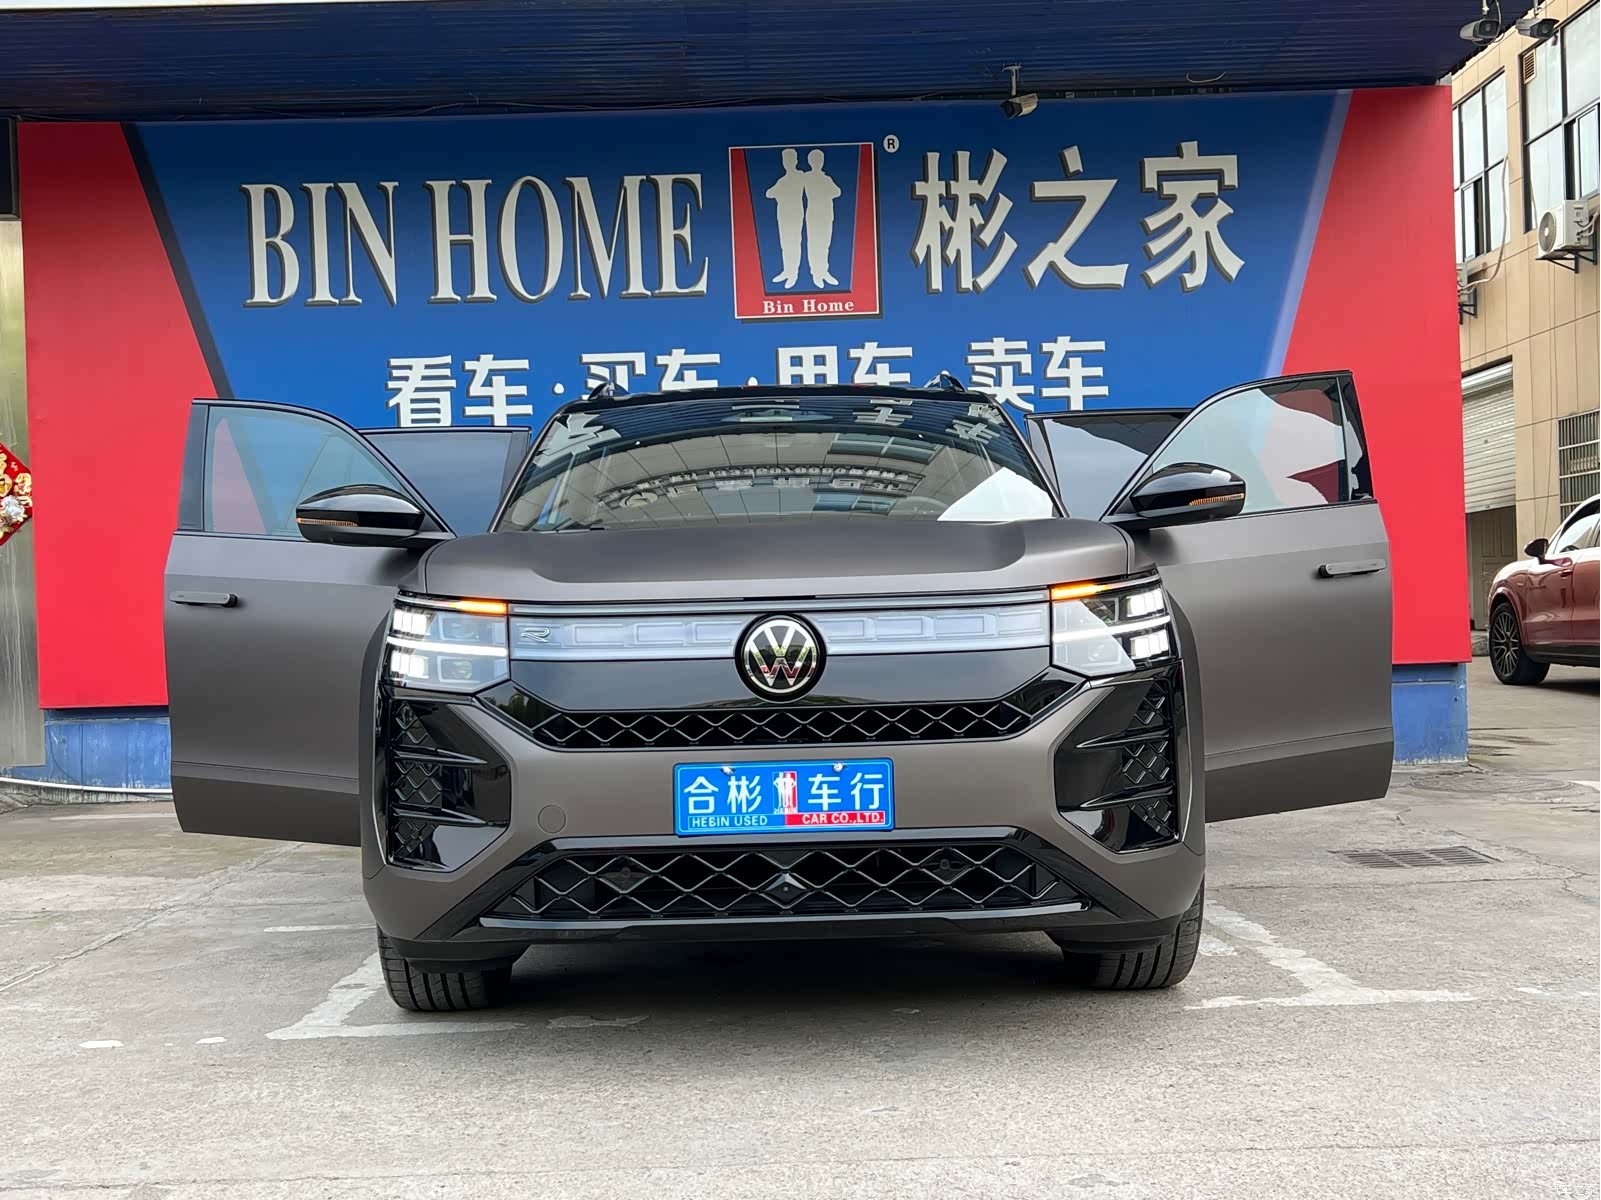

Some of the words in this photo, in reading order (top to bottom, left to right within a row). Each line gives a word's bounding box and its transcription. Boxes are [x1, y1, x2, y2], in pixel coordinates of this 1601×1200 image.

[911, 141, 1245, 294] 彬之家
[241, 180, 399, 306] BIN
[423, 174, 708, 303] HOME
[762, 300, 794, 314] Bin
[802, 299, 855, 313] Home
[684, 775, 762, 814] 合彬
[807, 772, 885, 811] 车行
[692, 816, 731, 828] HEBIN
[734, 815, 768, 827] USED
[802, 813, 828, 825] CAR
[831, 811, 885, 824] CO.,LTD.
